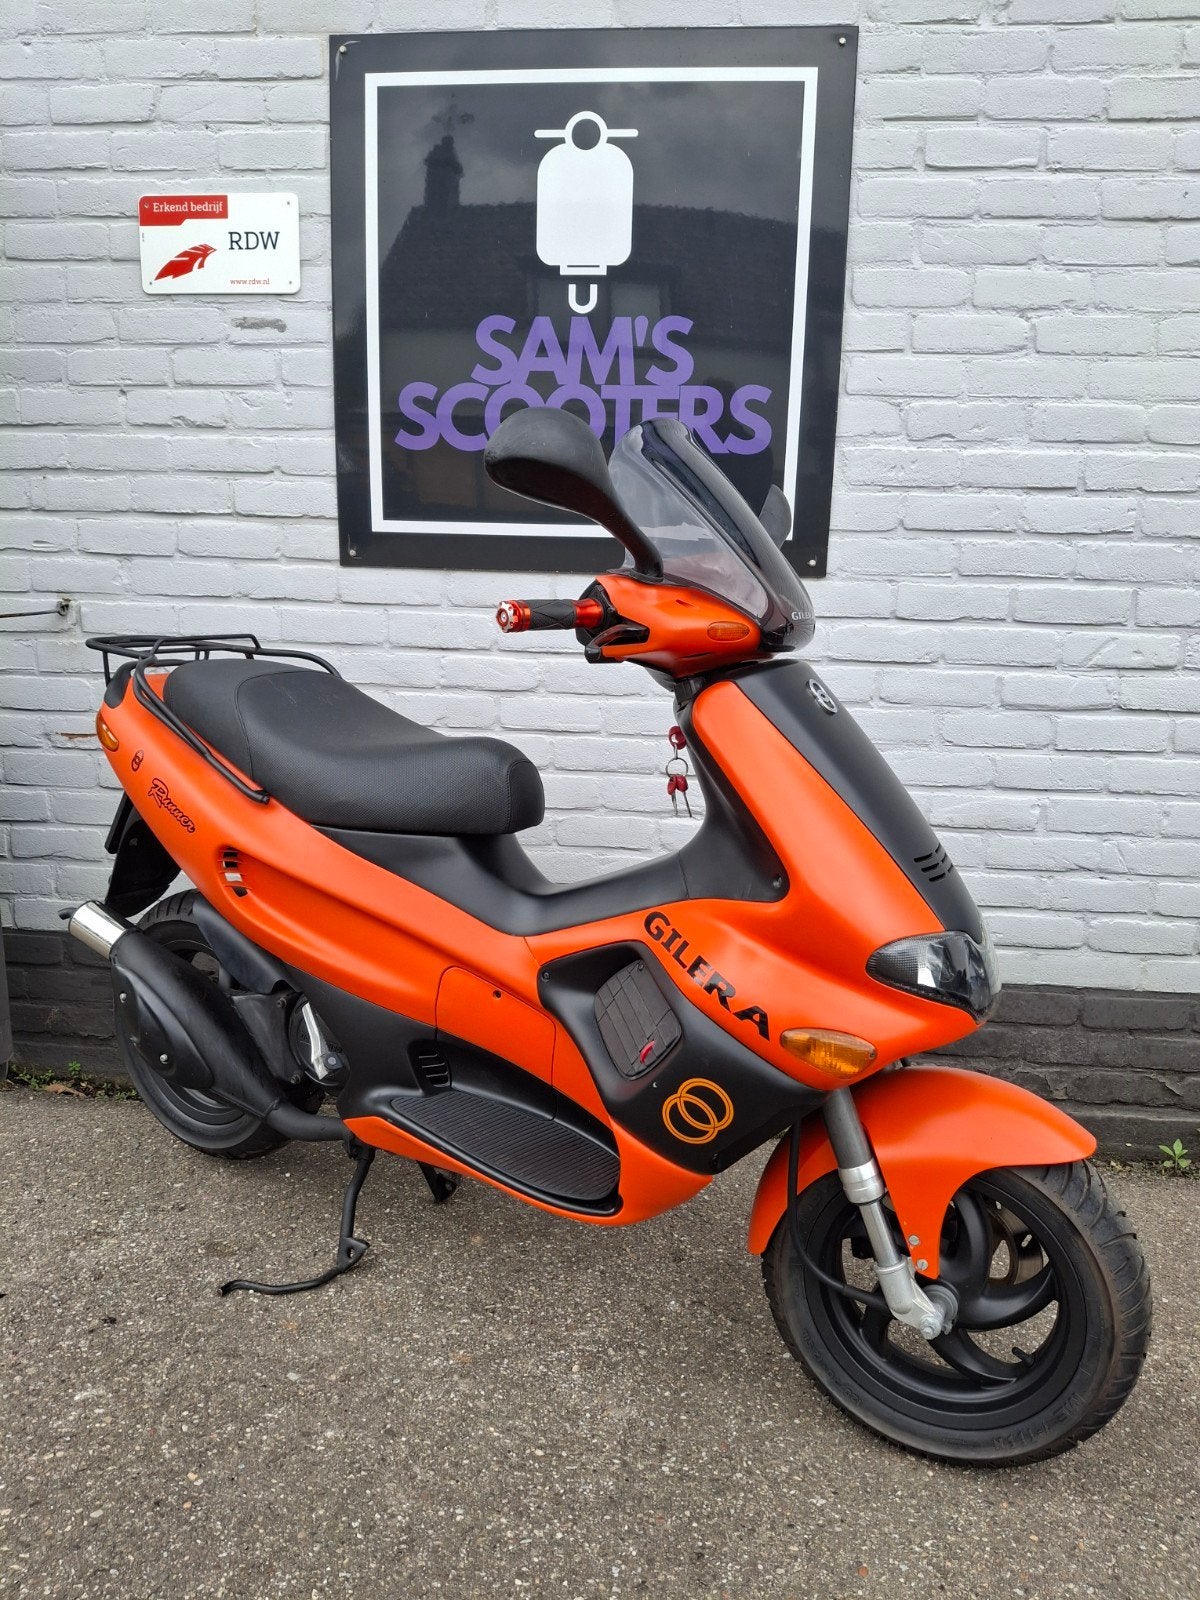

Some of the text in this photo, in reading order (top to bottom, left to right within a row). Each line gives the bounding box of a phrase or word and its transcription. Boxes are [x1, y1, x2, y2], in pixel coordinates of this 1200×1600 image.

[153, 201, 223, 214] Erkend bedrijf
[228, 231, 280, 250] RDW
[230, 277, 270, 285] www.rdw.nl
[470, 314, 695, 386] SAM'S
[148, 777, 196, 834] Runner
[643, 911, 770, 1042] GILERA
